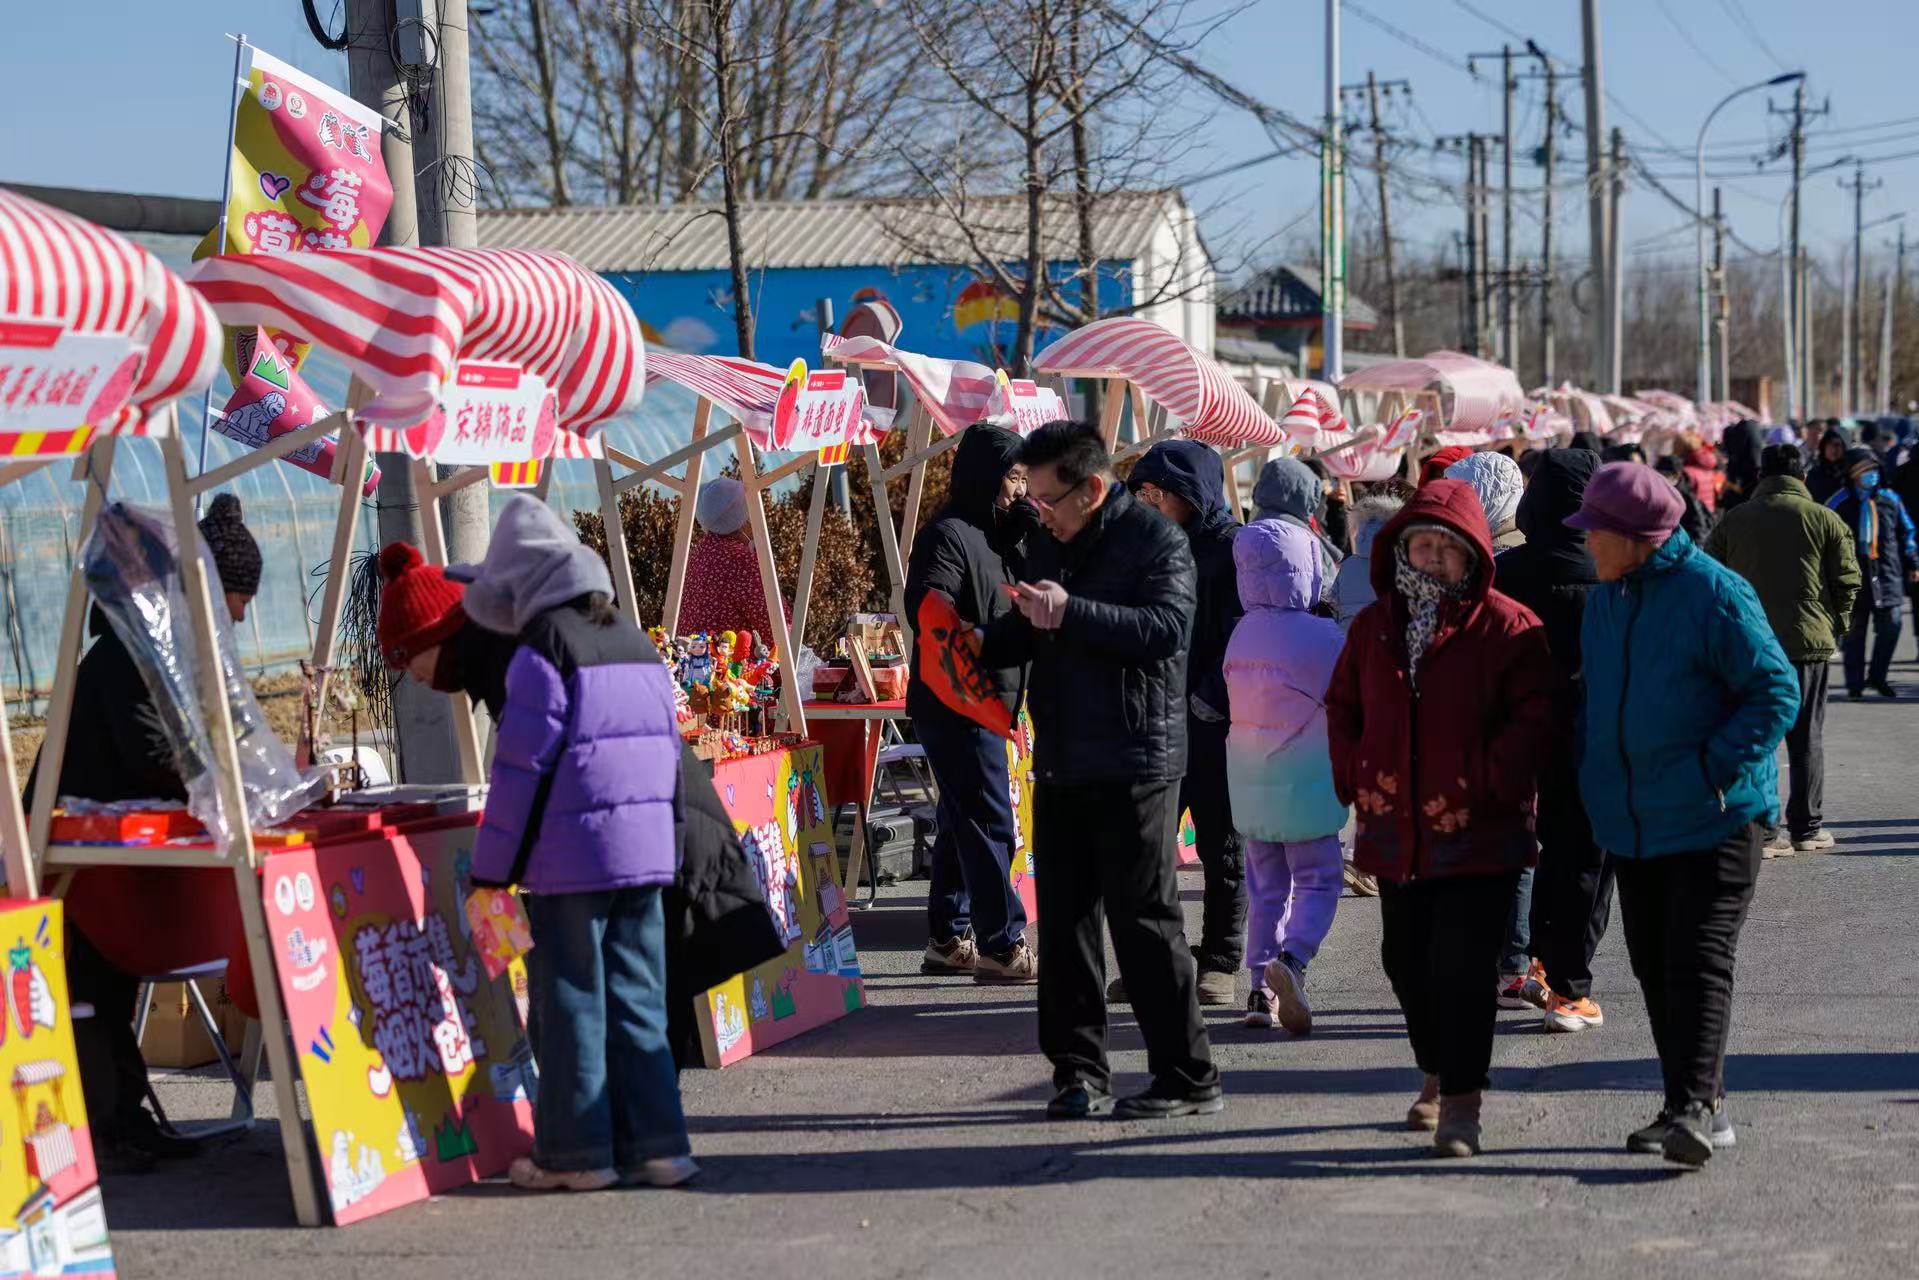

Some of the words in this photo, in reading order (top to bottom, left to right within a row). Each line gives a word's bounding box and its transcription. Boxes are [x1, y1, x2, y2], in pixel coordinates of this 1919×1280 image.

[454, 398, 527, 447] 宋锦饰品
[801, 399, 848, 438] 非遗面塑
